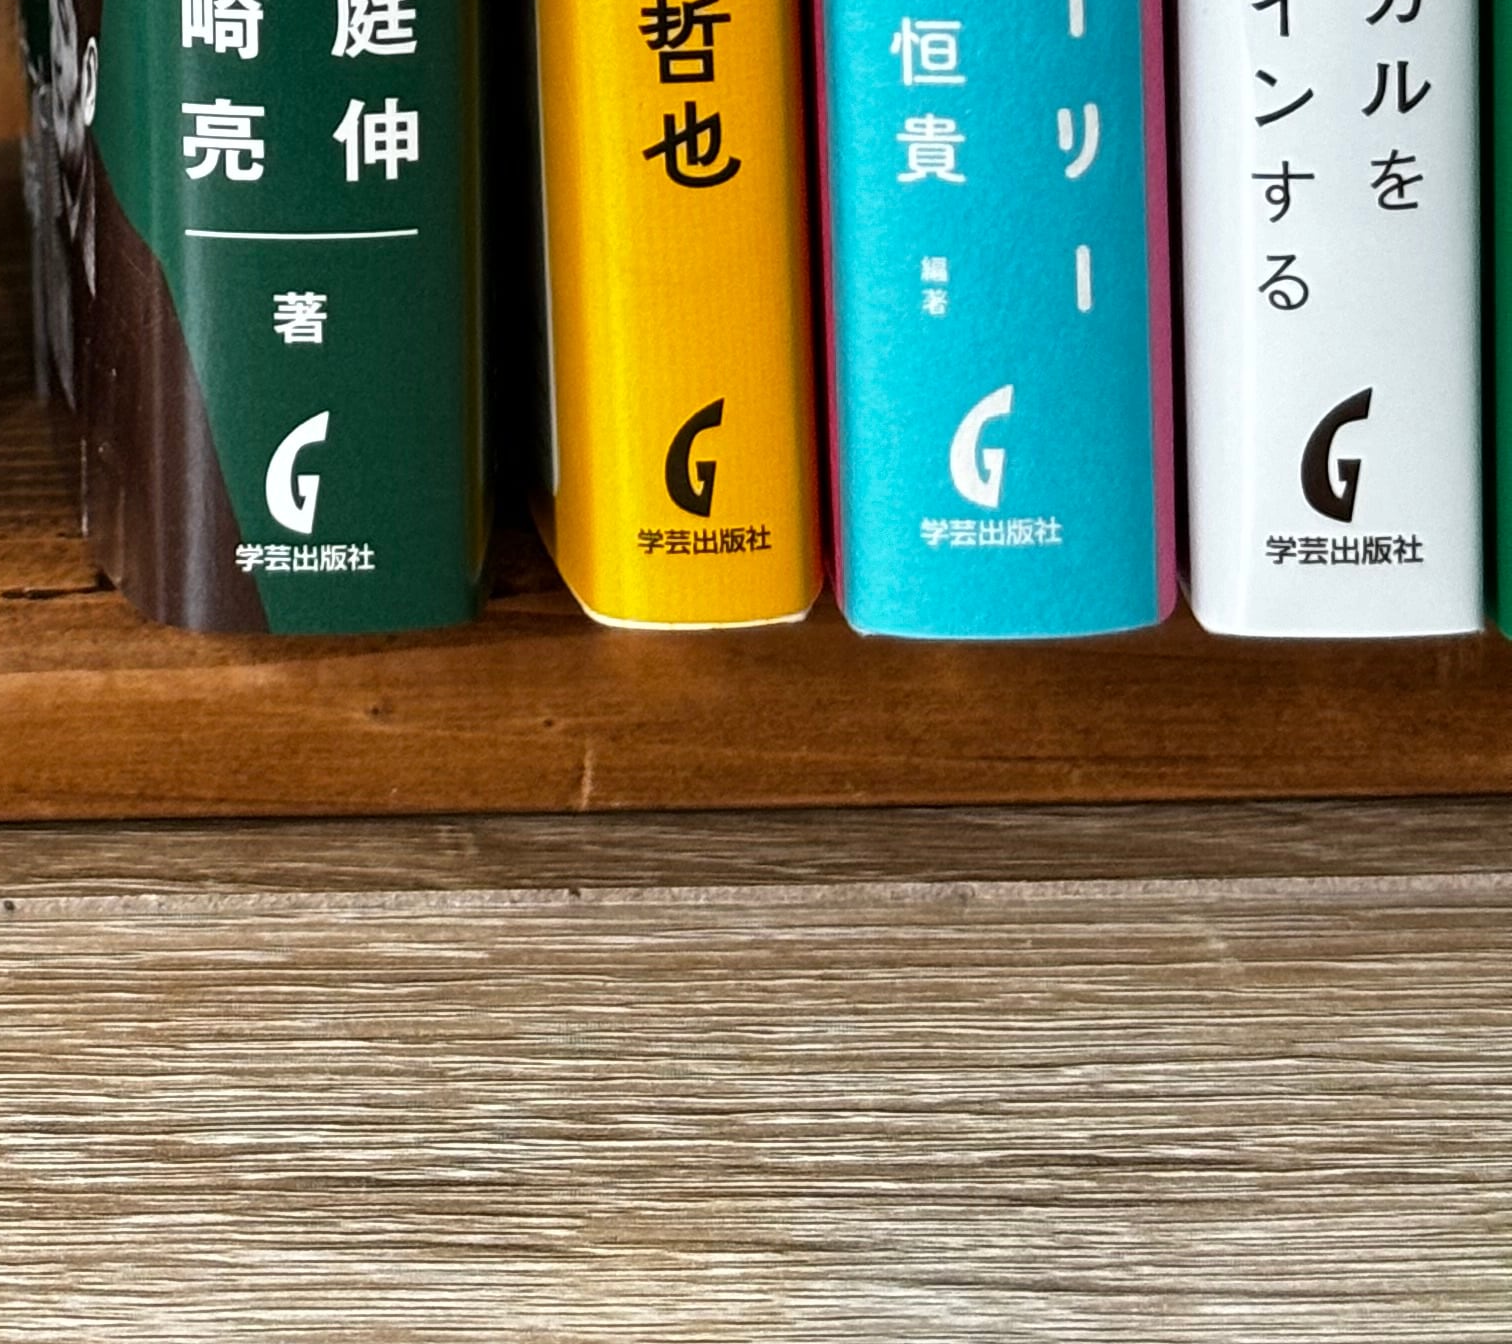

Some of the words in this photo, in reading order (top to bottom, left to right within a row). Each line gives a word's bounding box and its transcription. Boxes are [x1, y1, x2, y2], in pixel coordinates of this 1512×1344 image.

[920, 256, 949, 316] 編著
[273, 291, 328, 345] 著
[637, 524, 773, 555] 学芸出版社
[919, 516, 1063, 547] 学芸出版社
[235, 543, 375, 572] 学芸出版社
[1266, 535, 1424, 565] 学芸出版社
